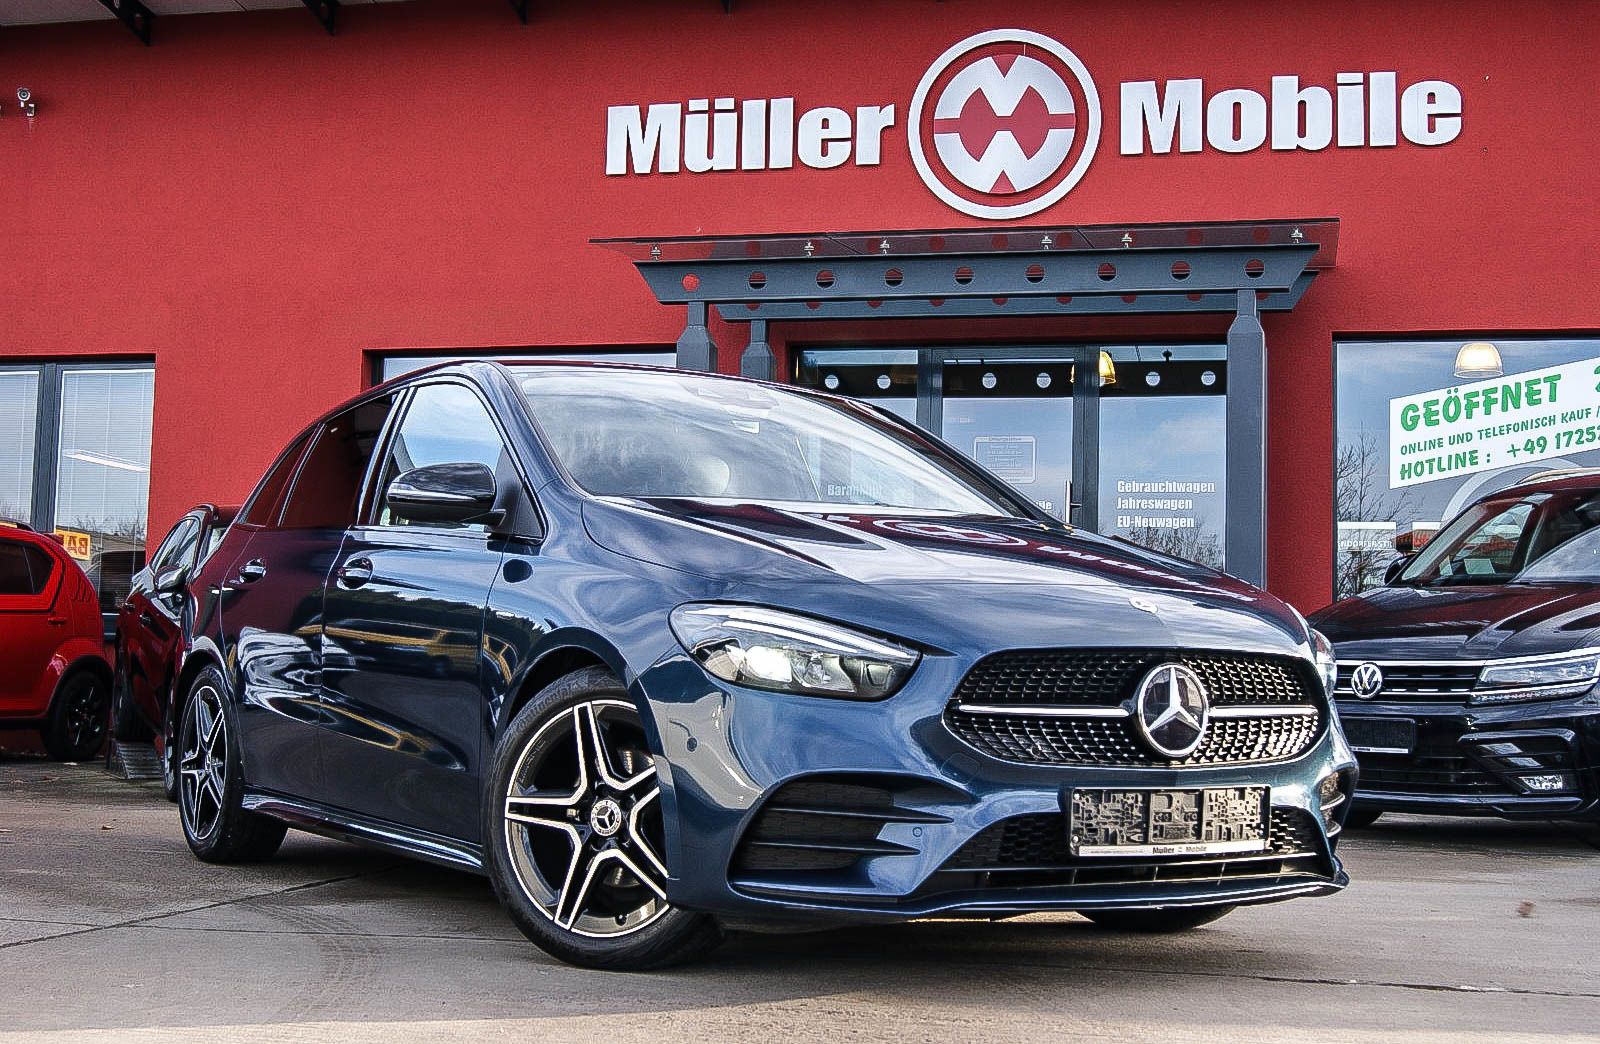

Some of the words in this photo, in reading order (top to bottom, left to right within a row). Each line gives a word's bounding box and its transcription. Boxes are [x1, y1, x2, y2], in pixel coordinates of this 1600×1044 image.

[605, 96, 895, 176] Müller
[1120, 71, 1463, 155] Mobile
[1400, 373, 1561, 432] GEÖFFNET
[1400, 437, 1444, 456] ONLINE
[1448, 432, 1473, 446] UND
[1477, 414, 1557, 441] TELEFONISCH
[1560, 407, 1592, 424] KAUF
[1400, 449, 1478, 480] HOTLINE
[1506, 435, 1548, 458] +49
[1116, 480, 1216, 494] Gebrauchtwagen
[1116, 497, 1193, 511] Jahreswagen
[1116, 515, 1195, 529] EU-Neuwagen
